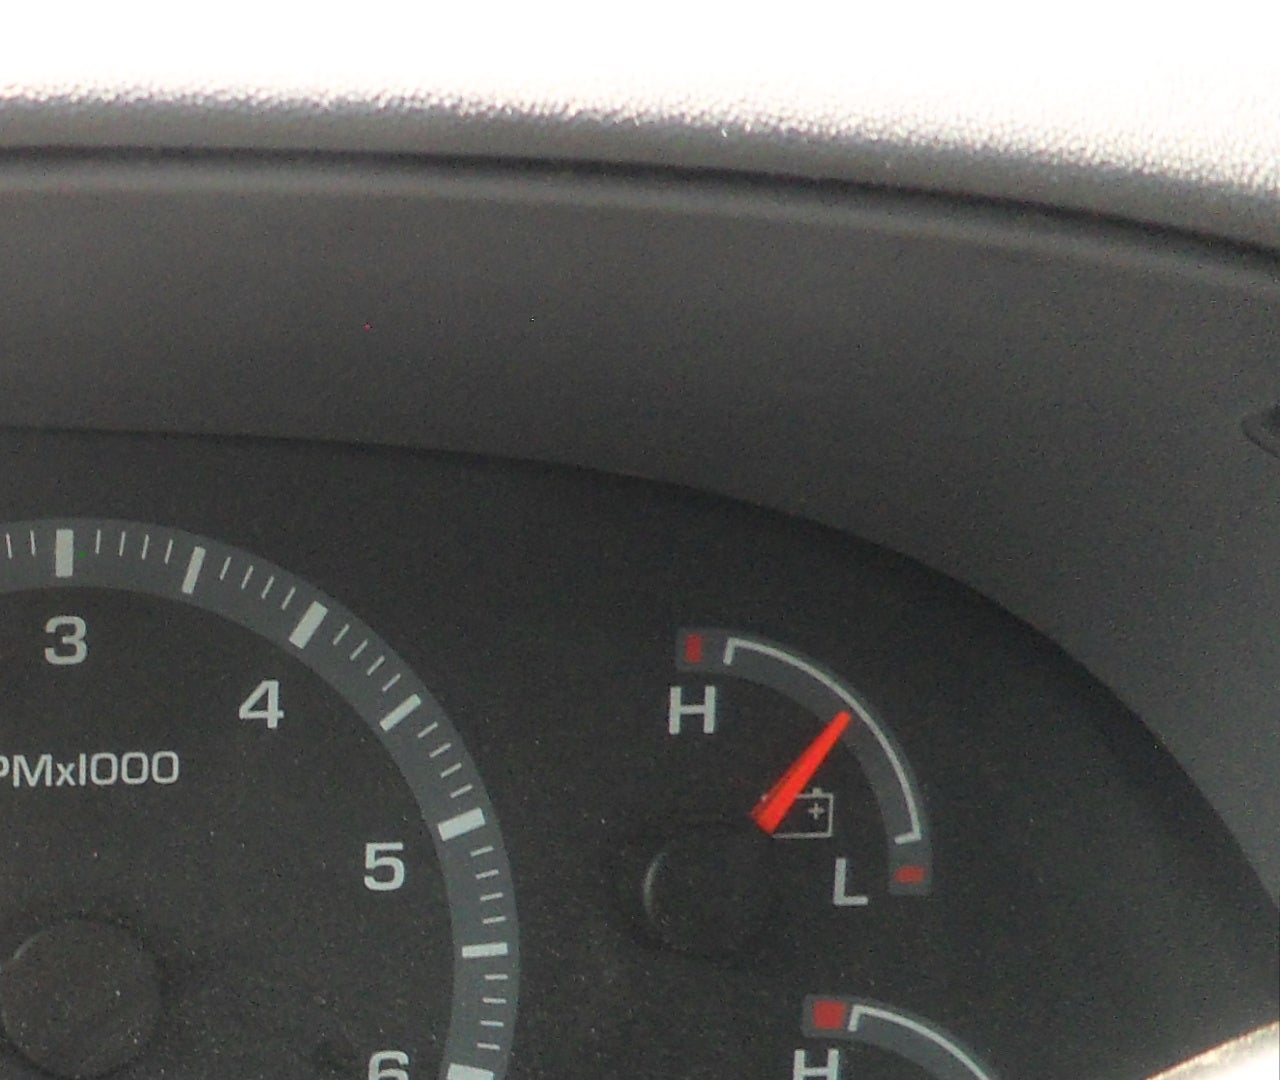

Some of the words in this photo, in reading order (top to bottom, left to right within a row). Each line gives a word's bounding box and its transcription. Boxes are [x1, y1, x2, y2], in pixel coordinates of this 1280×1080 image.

[44, 615, 88, 665] 3
[238, 680, 285, 729] 4
[668, 685, 717, 735] H
[364, 842, 405, 891] 5
[833, 857, 869, 906] L
